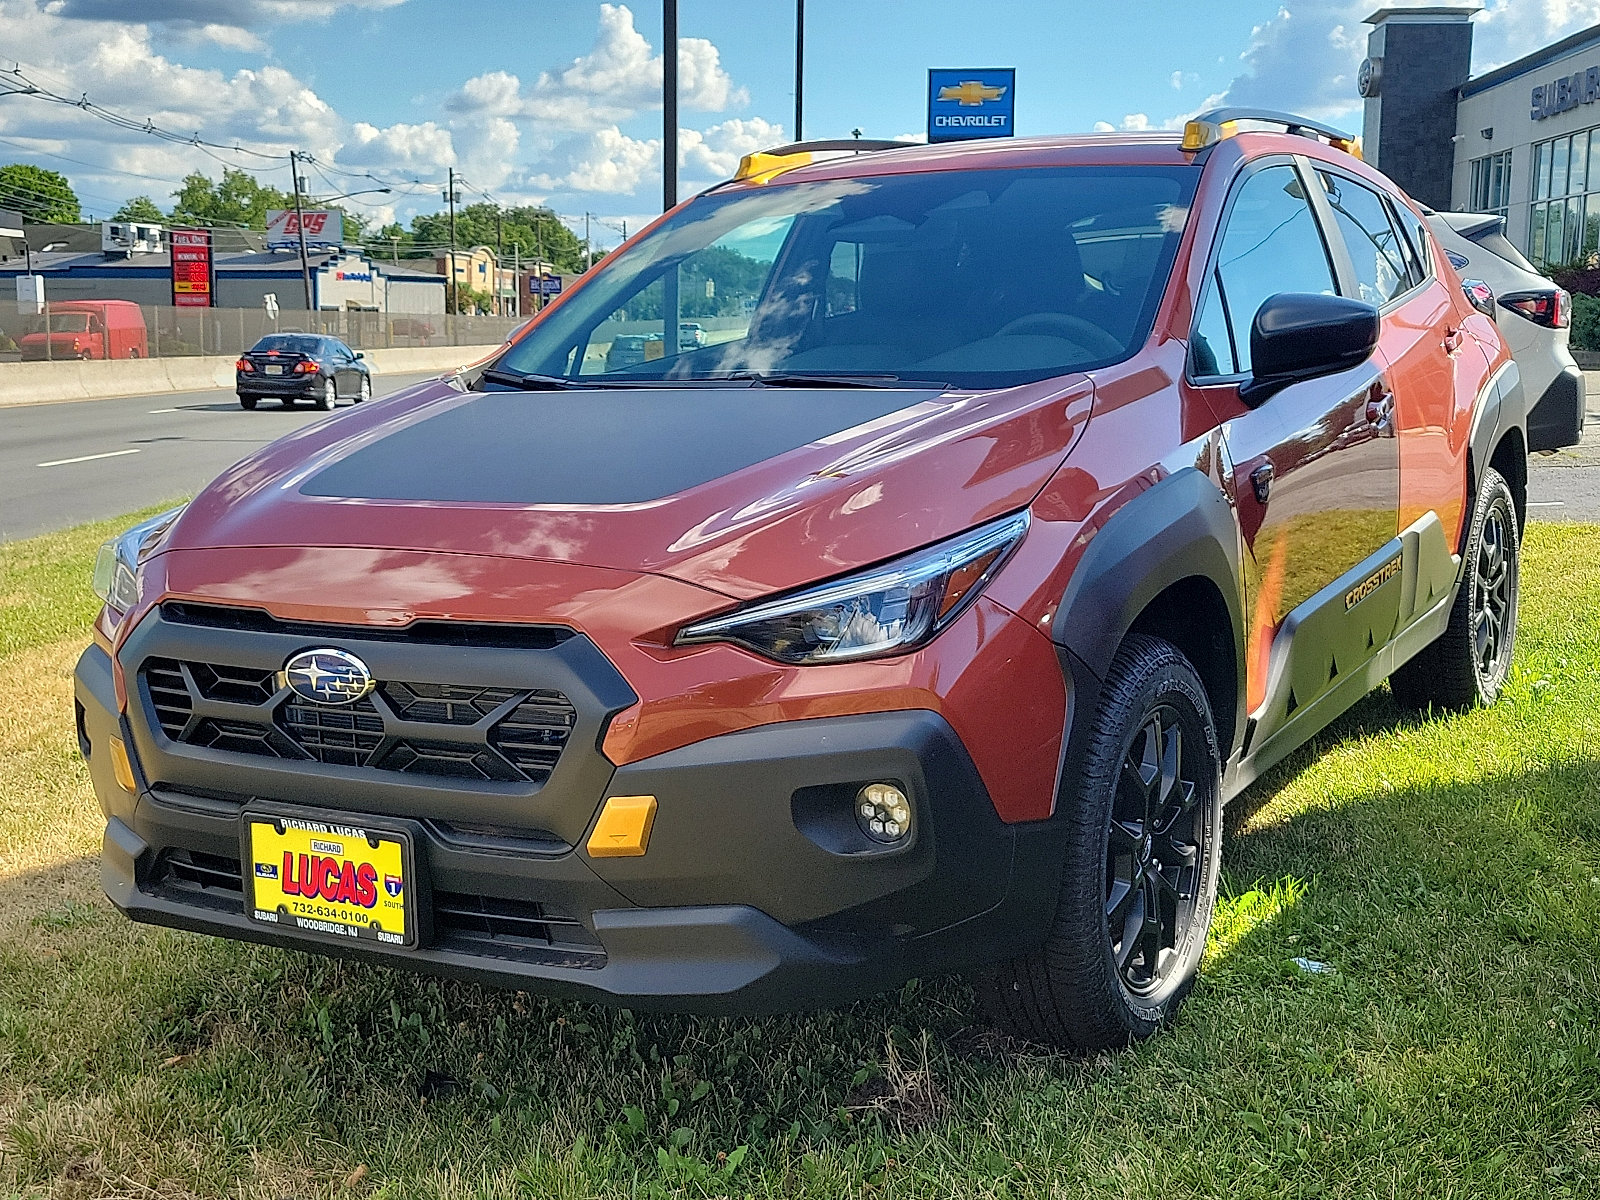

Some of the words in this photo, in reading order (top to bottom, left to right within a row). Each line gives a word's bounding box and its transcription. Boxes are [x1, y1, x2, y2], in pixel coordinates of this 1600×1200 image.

[935, 115, 1007, 127] CHEVROLET
[1344, 553, 1402, 611] CROSSTREK
[280, 818, 328, 834] RICHARD
[330, 825, 367, 839] LUCAS
[313, 841, 342, 854] RICHARD
[282, 850, 379, 909] LUCAS
[389, 882, 398, 896] 1
[292, 901, 369, 924] 732-634-0100
[383, 900, 405, 911] SOUTH
[254, 910, 279, 923] SUBARU
[296, 916, 347, 936] WOODBRIDGE,
[347, 925, 358, 938] NJ
[377, 931, 404, 945] SUBARU
